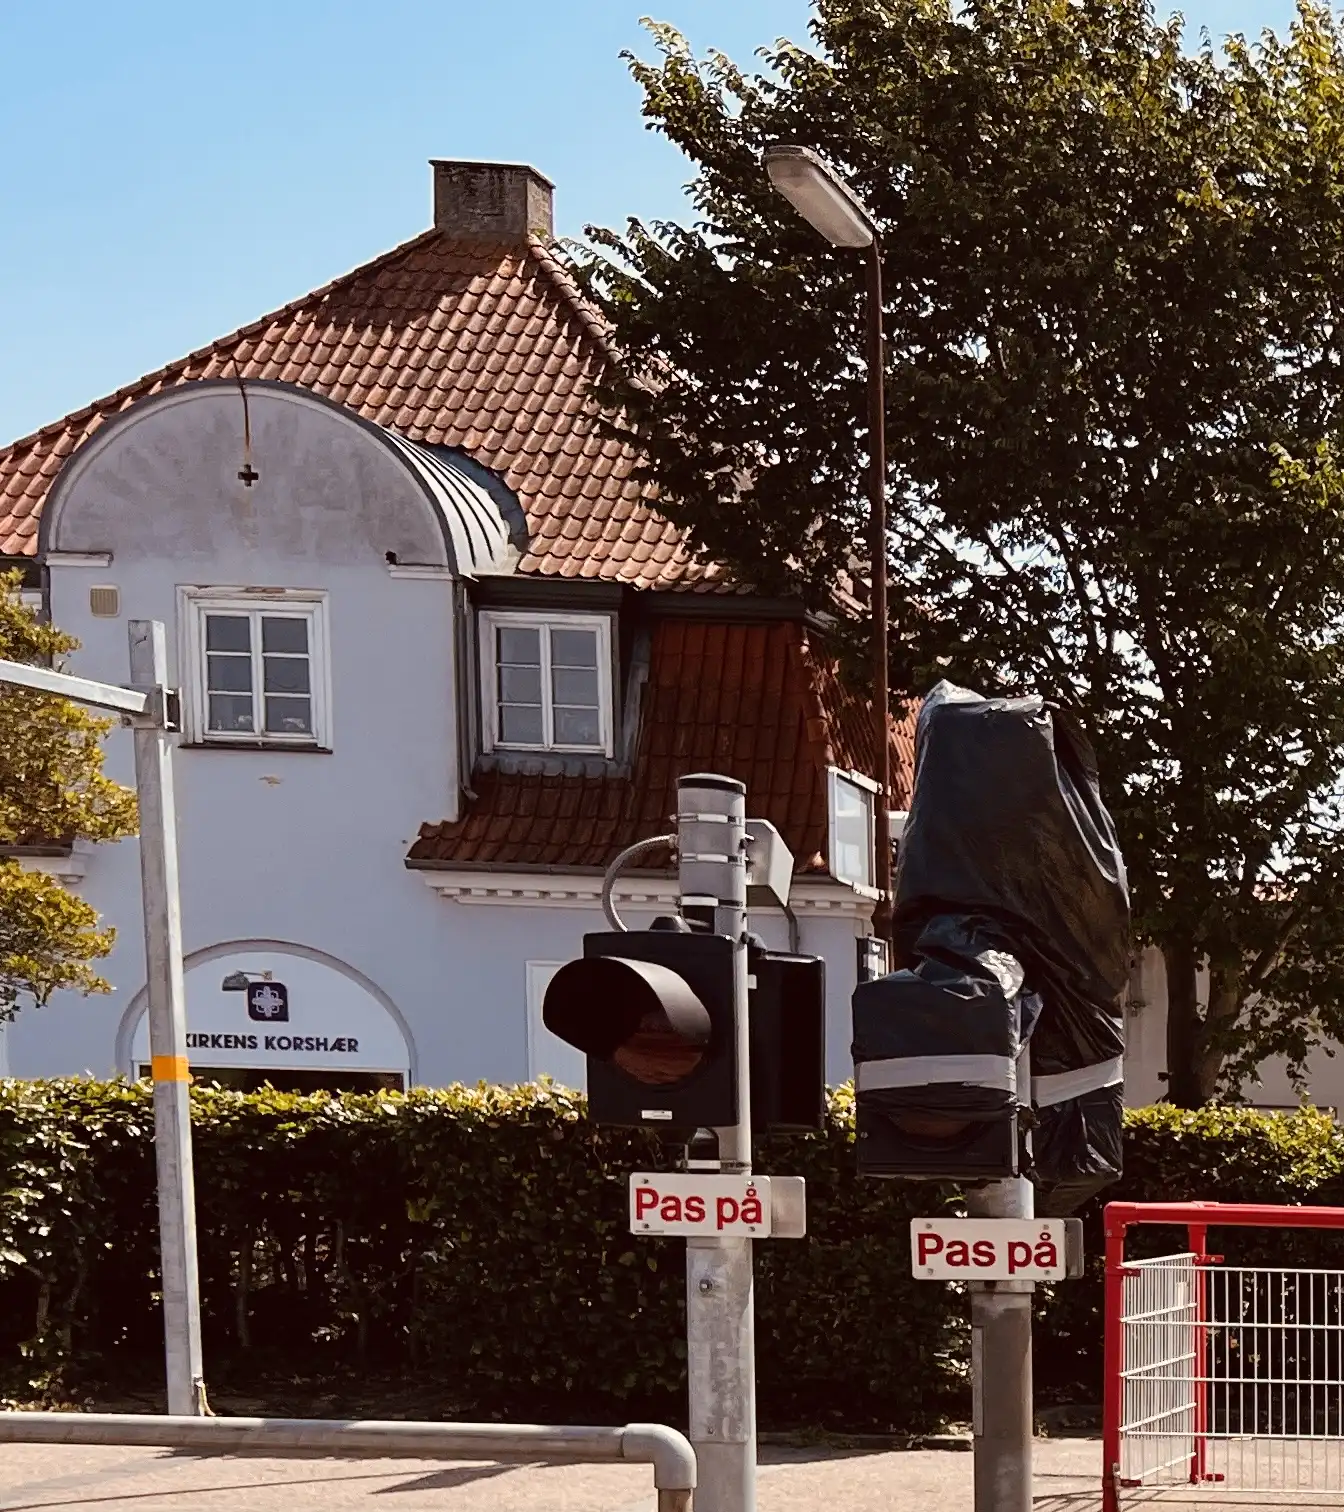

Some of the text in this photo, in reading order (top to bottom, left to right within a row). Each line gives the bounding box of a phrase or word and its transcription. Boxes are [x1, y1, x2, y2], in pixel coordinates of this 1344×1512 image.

[264, 1036, 359, 1052] KORSHÆR
[635, 1187, 763, 1231] Pas på
[917, 1231, 1058, 1275] Pas på
